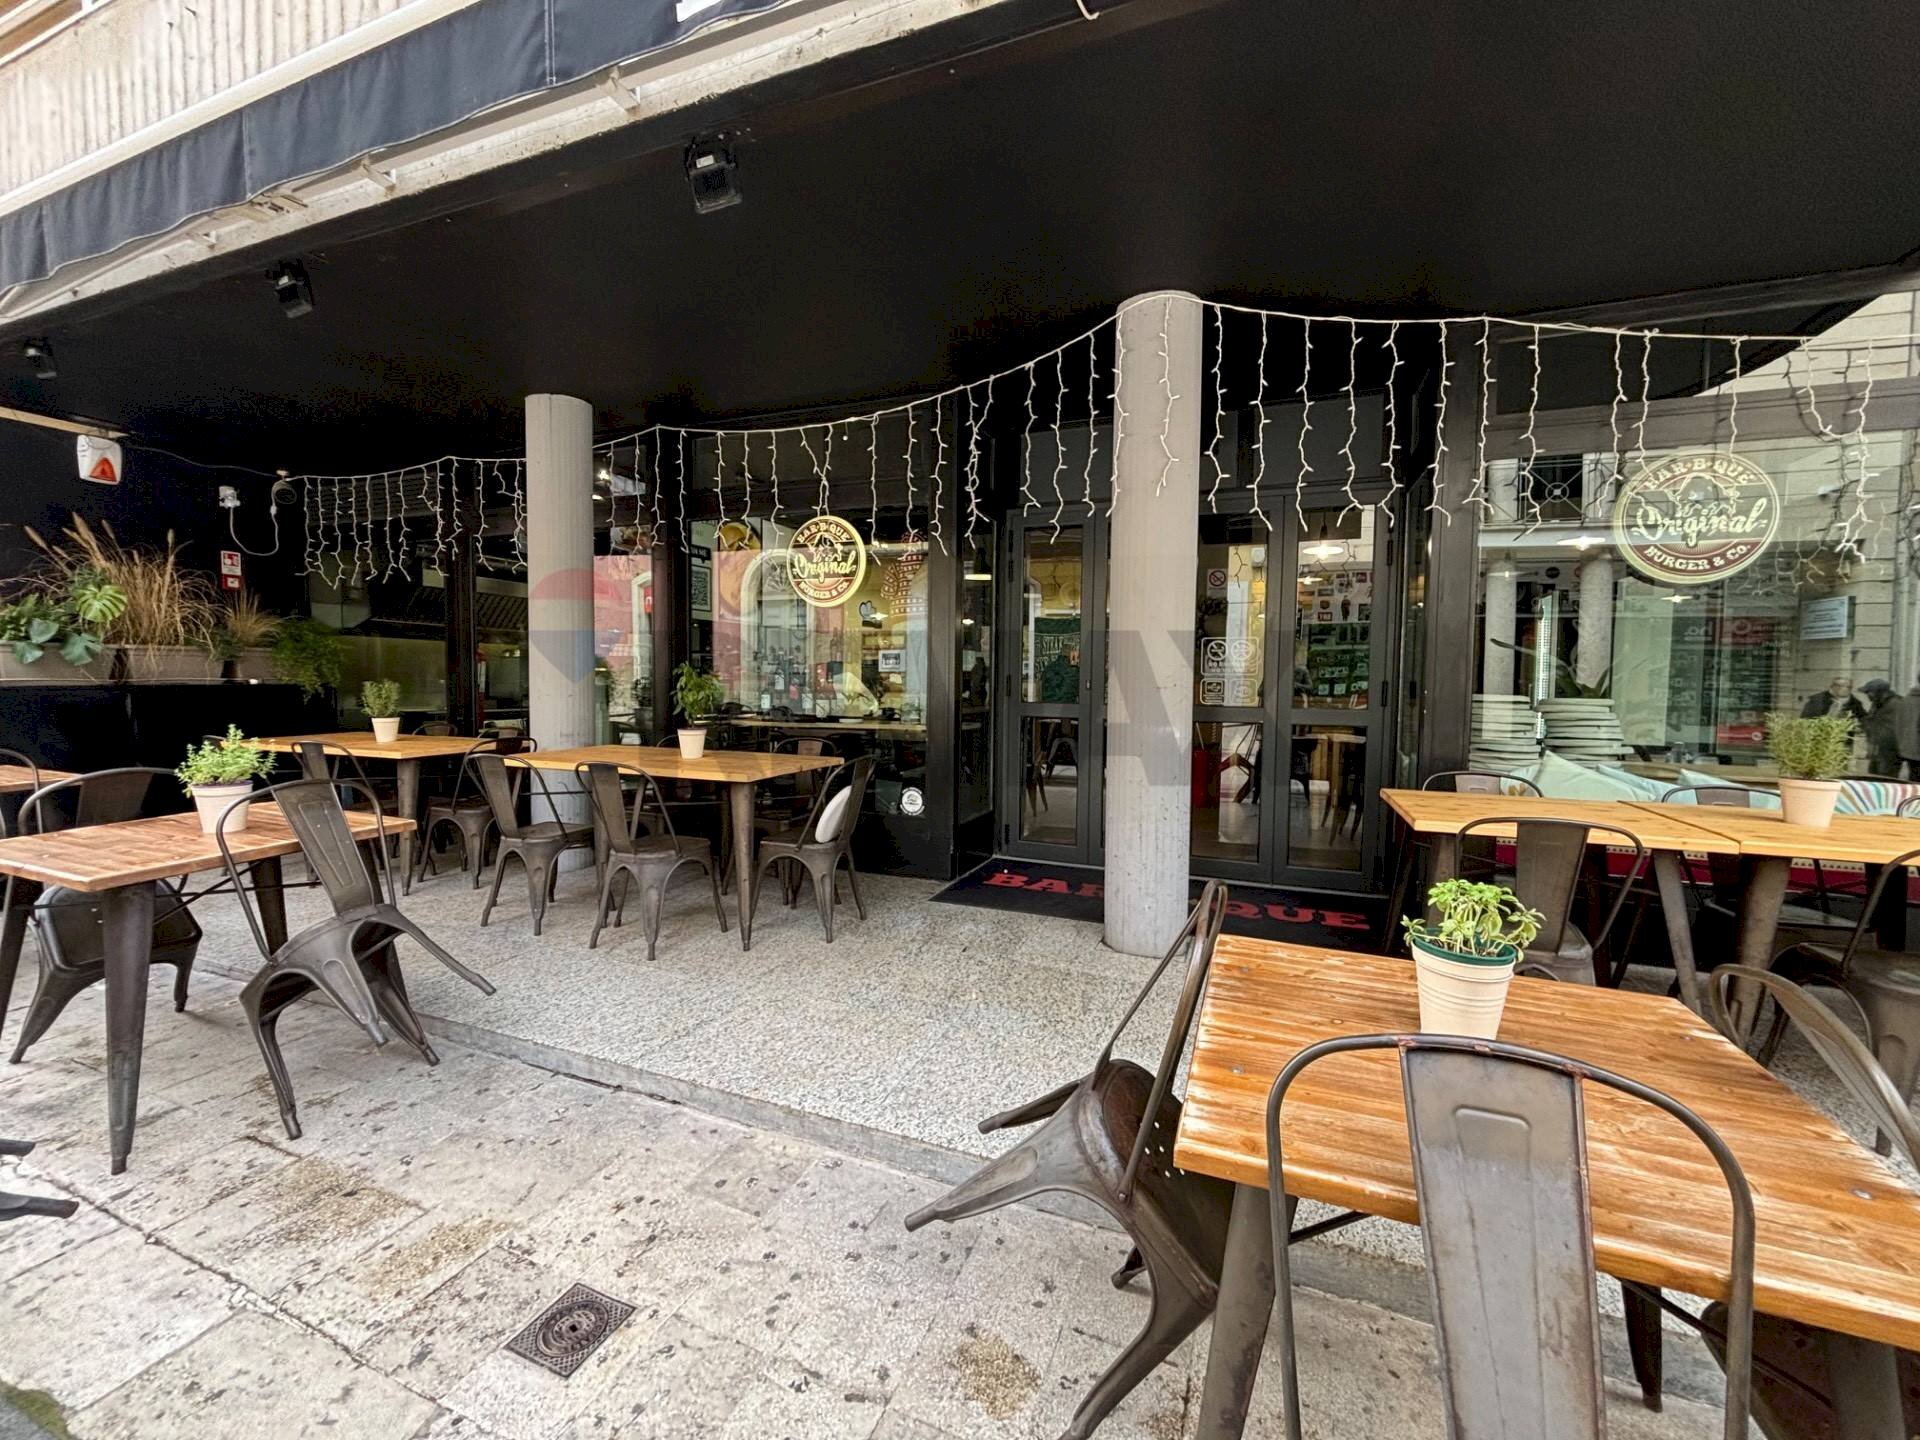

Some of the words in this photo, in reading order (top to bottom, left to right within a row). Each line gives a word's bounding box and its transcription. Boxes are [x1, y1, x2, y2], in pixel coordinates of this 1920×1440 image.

[1635, 497, 1768, 548] Original
[793, 550, 856, 583] Original
[1644, 546, 1710, 571] BURGER
[1712, 557, 1725, 568] &
